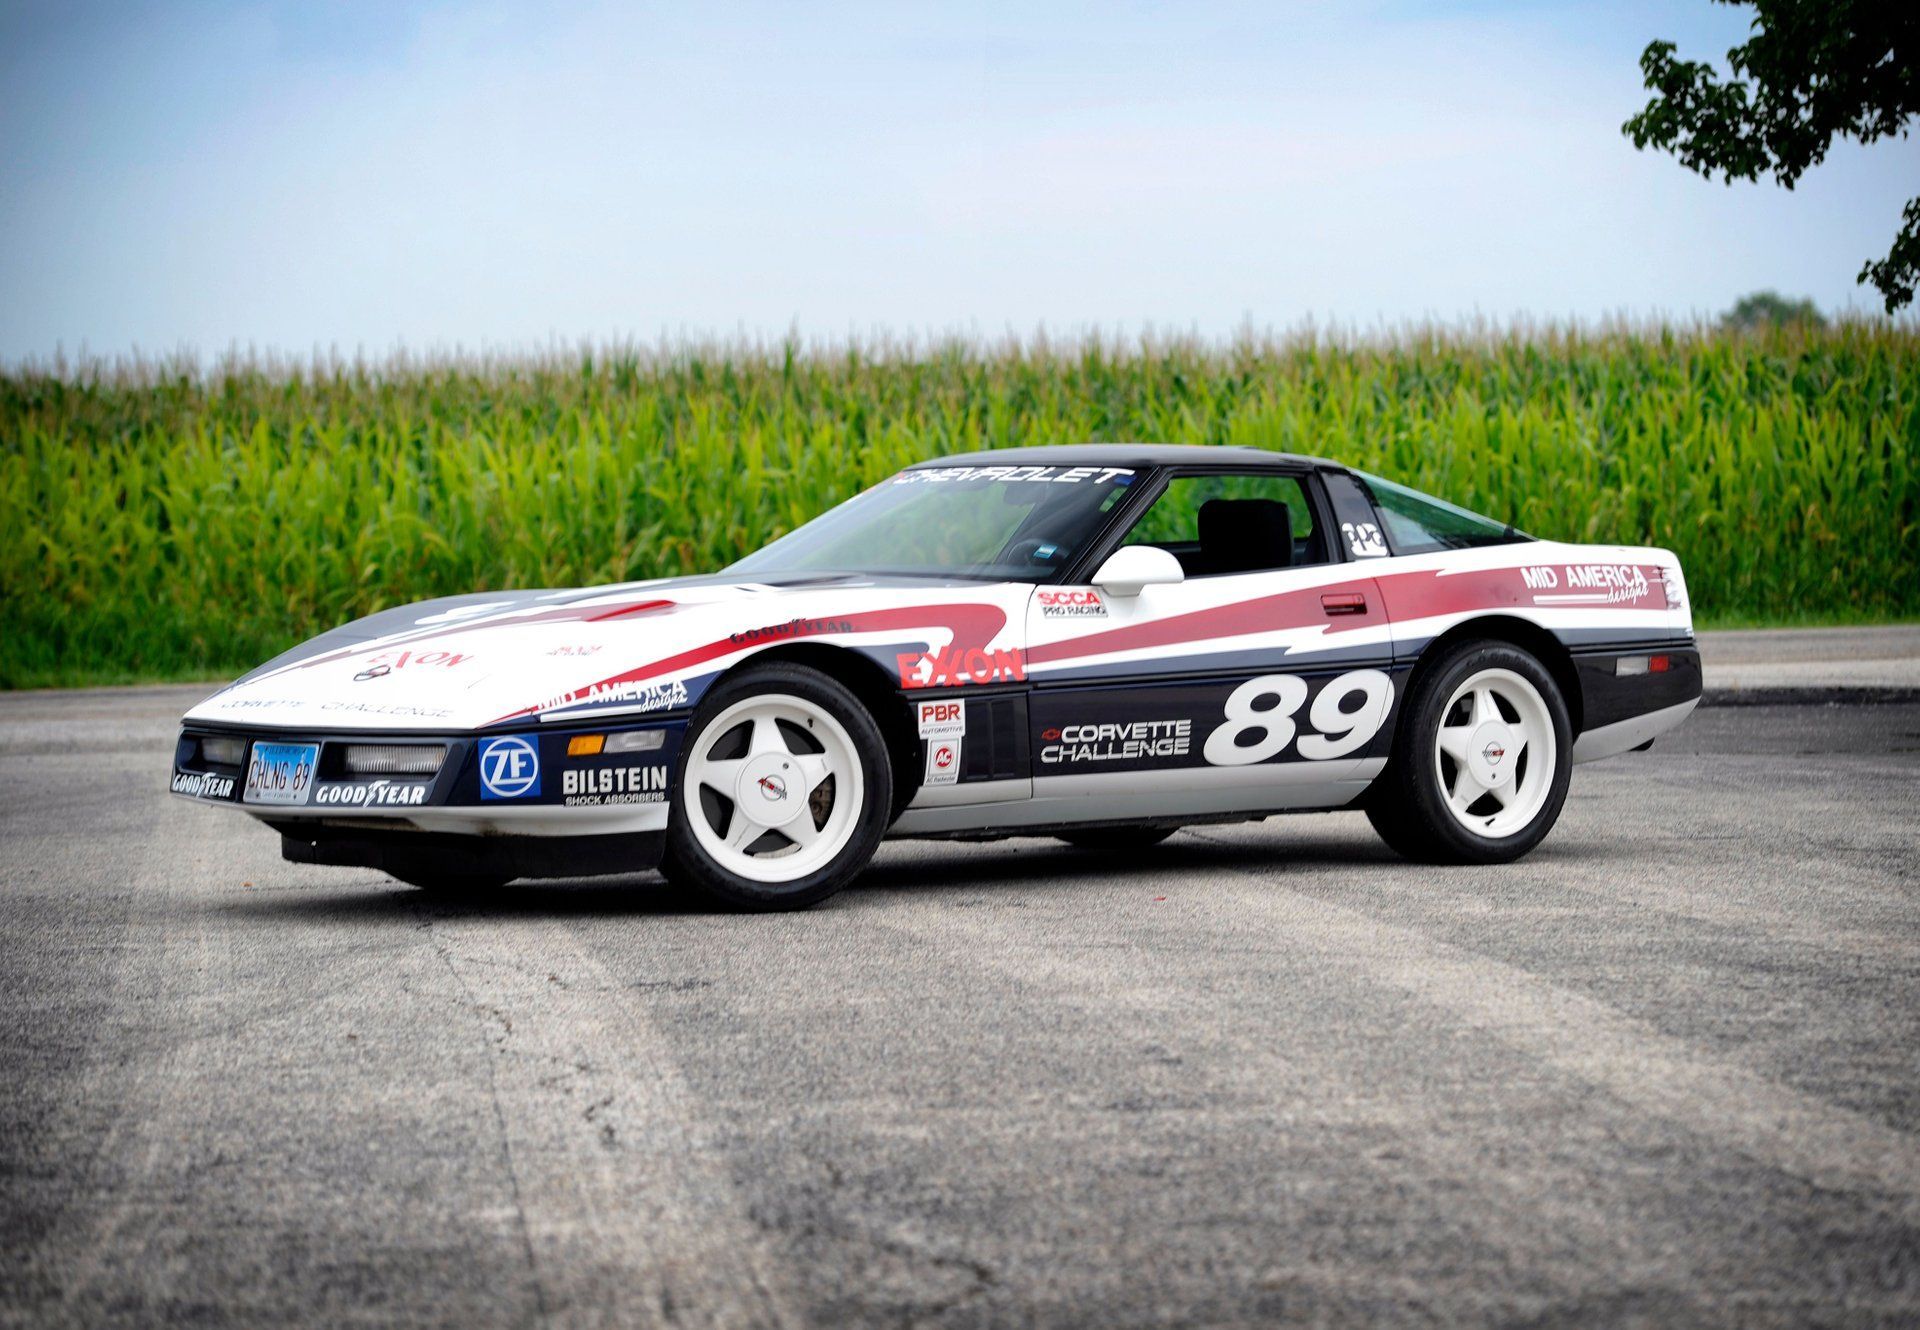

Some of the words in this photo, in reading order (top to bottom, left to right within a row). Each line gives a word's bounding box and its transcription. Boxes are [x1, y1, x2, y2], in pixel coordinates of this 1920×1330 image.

[1520, 566, 1558, 589] MID
[1565, 565, 1648, 588] AMERICA
[1037, 592, 1101, 606] SCCA
[897, 645, 1025, 689] EXXON
[586, 680, 688, 703] AMERICA
[921, 703, 961, 723] PBR
[1203, 669, 1395, 766] 89
[1061, 719, 1192, 744] CORVETTE
[1040, 737, 1191, 763] CHALLENGE
[248, 760, 289, 790] CHLNG
[293, 763, 310, 791] 89
[486, 747, 532, 787] ZF
[563, 765, 667, 795] BILSTEIN
[172, 771, 234, 798] GOODYEAR
[315, 780, 426, 808] GOODYEAR
[565, 795, 602, 807] SHOCK
[604, 792, 666, 805] ABSORBERS
